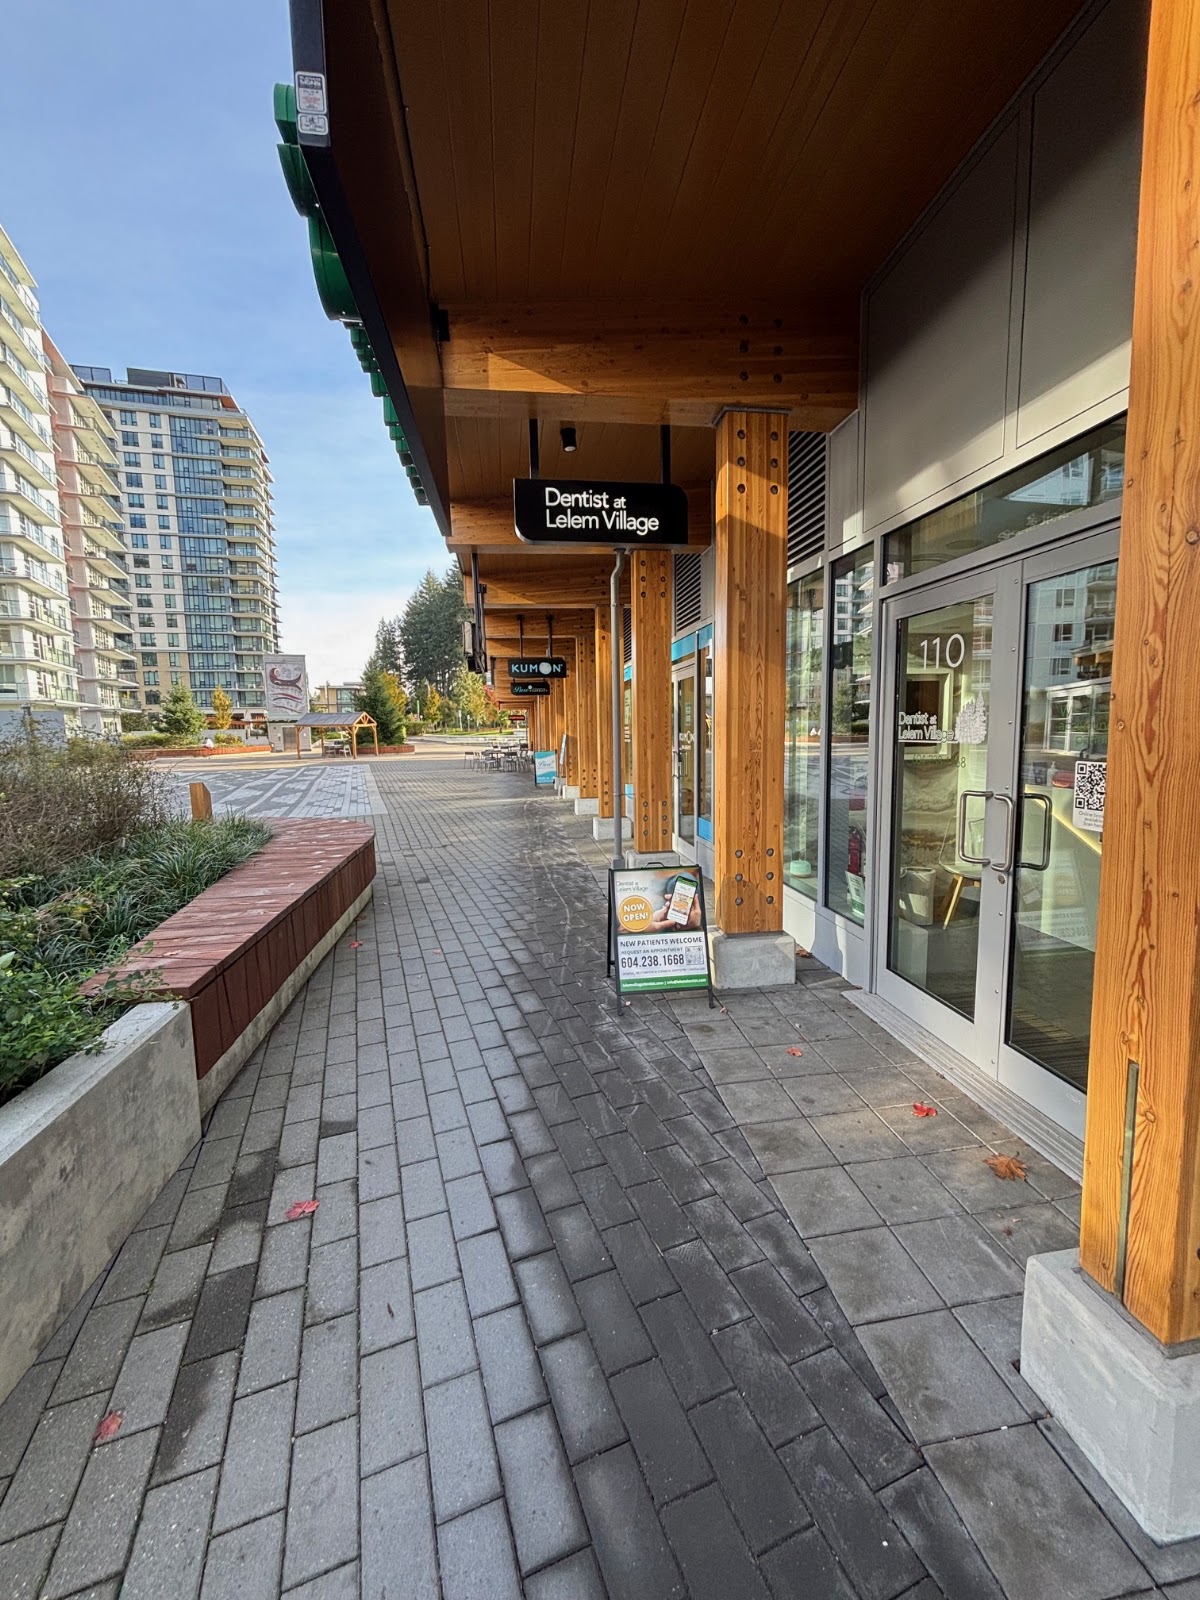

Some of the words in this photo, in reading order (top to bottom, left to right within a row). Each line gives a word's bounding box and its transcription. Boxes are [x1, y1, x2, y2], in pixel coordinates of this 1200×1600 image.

[545, 487, 609, 508] Dentist
[613, 496, 627, 509] at
[546, 509, 599, 529] Lelem
[602, 511, 660, 536] Village
[920, 633, 965, 670] 110
[511, 662, 563, 675] KUMON
[898, 711, 929, 725] Dentist
[929, 714, 938, 724] at
[898, 725, 923, 740] Lelem
[924, 725, 955, 743] Village
[623, 903, 645, 912] NOW
[623, 912, 649, 922] OPEN!
[637, 938, 669, 946] PATIENTS
[670, 936, 703, 944] WELCOME
[621, 954, 685, 969] 604.238.1668
